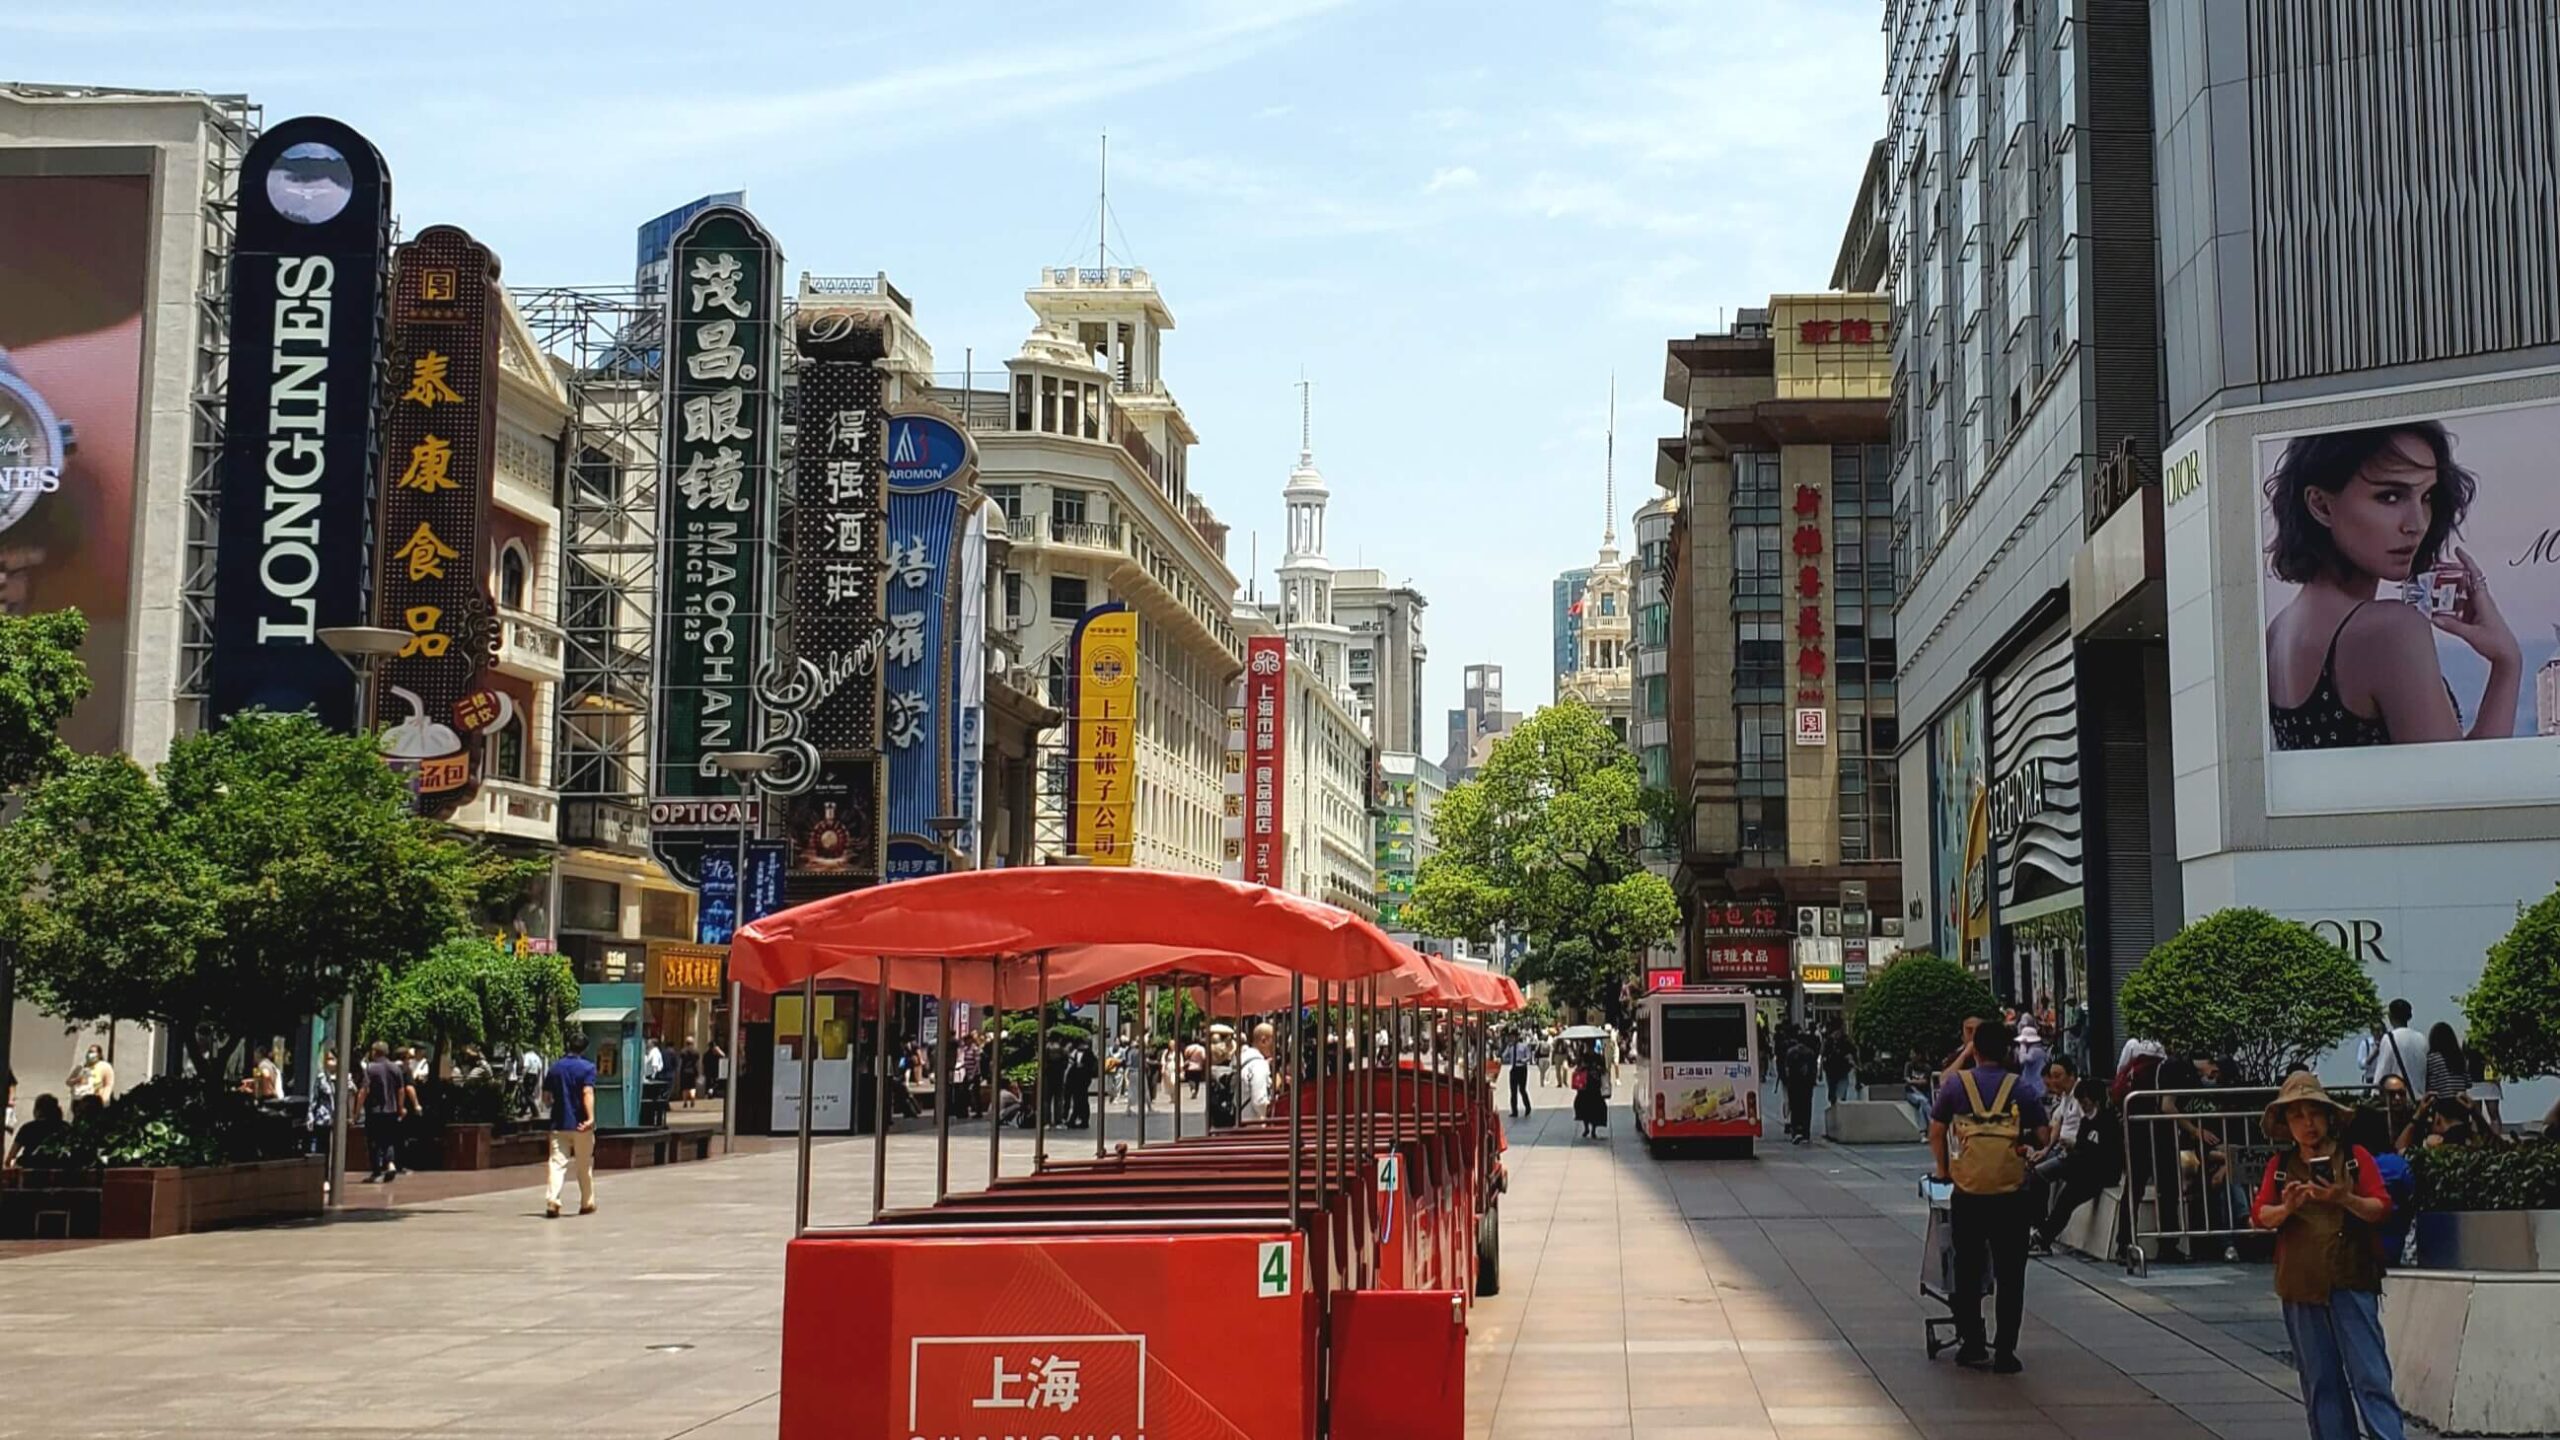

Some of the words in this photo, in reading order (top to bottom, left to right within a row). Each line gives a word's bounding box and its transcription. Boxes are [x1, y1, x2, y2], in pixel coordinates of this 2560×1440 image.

[677, 253, 751, 511] 茂昌眼镜
[257, 255, 336, 645] LONGINES
[2166, 449, 2201, 506] DIOR
[392, 350, 465, 658] 泰康食品
[686, 522, 704, 584] SINCE
[684, 594, 702, 642] 1923
[700, 522, 738, 778] MAOCHANG
[812, 624, 888, 712] champ
[963, 706, 978, 750] No.1
[1255, 684, 1274, 834] 上海市第一食品商店
[959, 760, 977, 854] Pharmcy
[1094, 699, 1118, 856] 上海帐子公司
[1987, 757, 2042, 839] SEPHORA
[651, 803, 758, 823] OPTICAL
[1257, 843, 1270, 869] First
[2308, 919, 2392, 963] OR
[1380, 1160, 1395, 1184] 4
[1262, 1246, 1287, 1293] 4
[972, 1355, 1080, 1412] 上海
